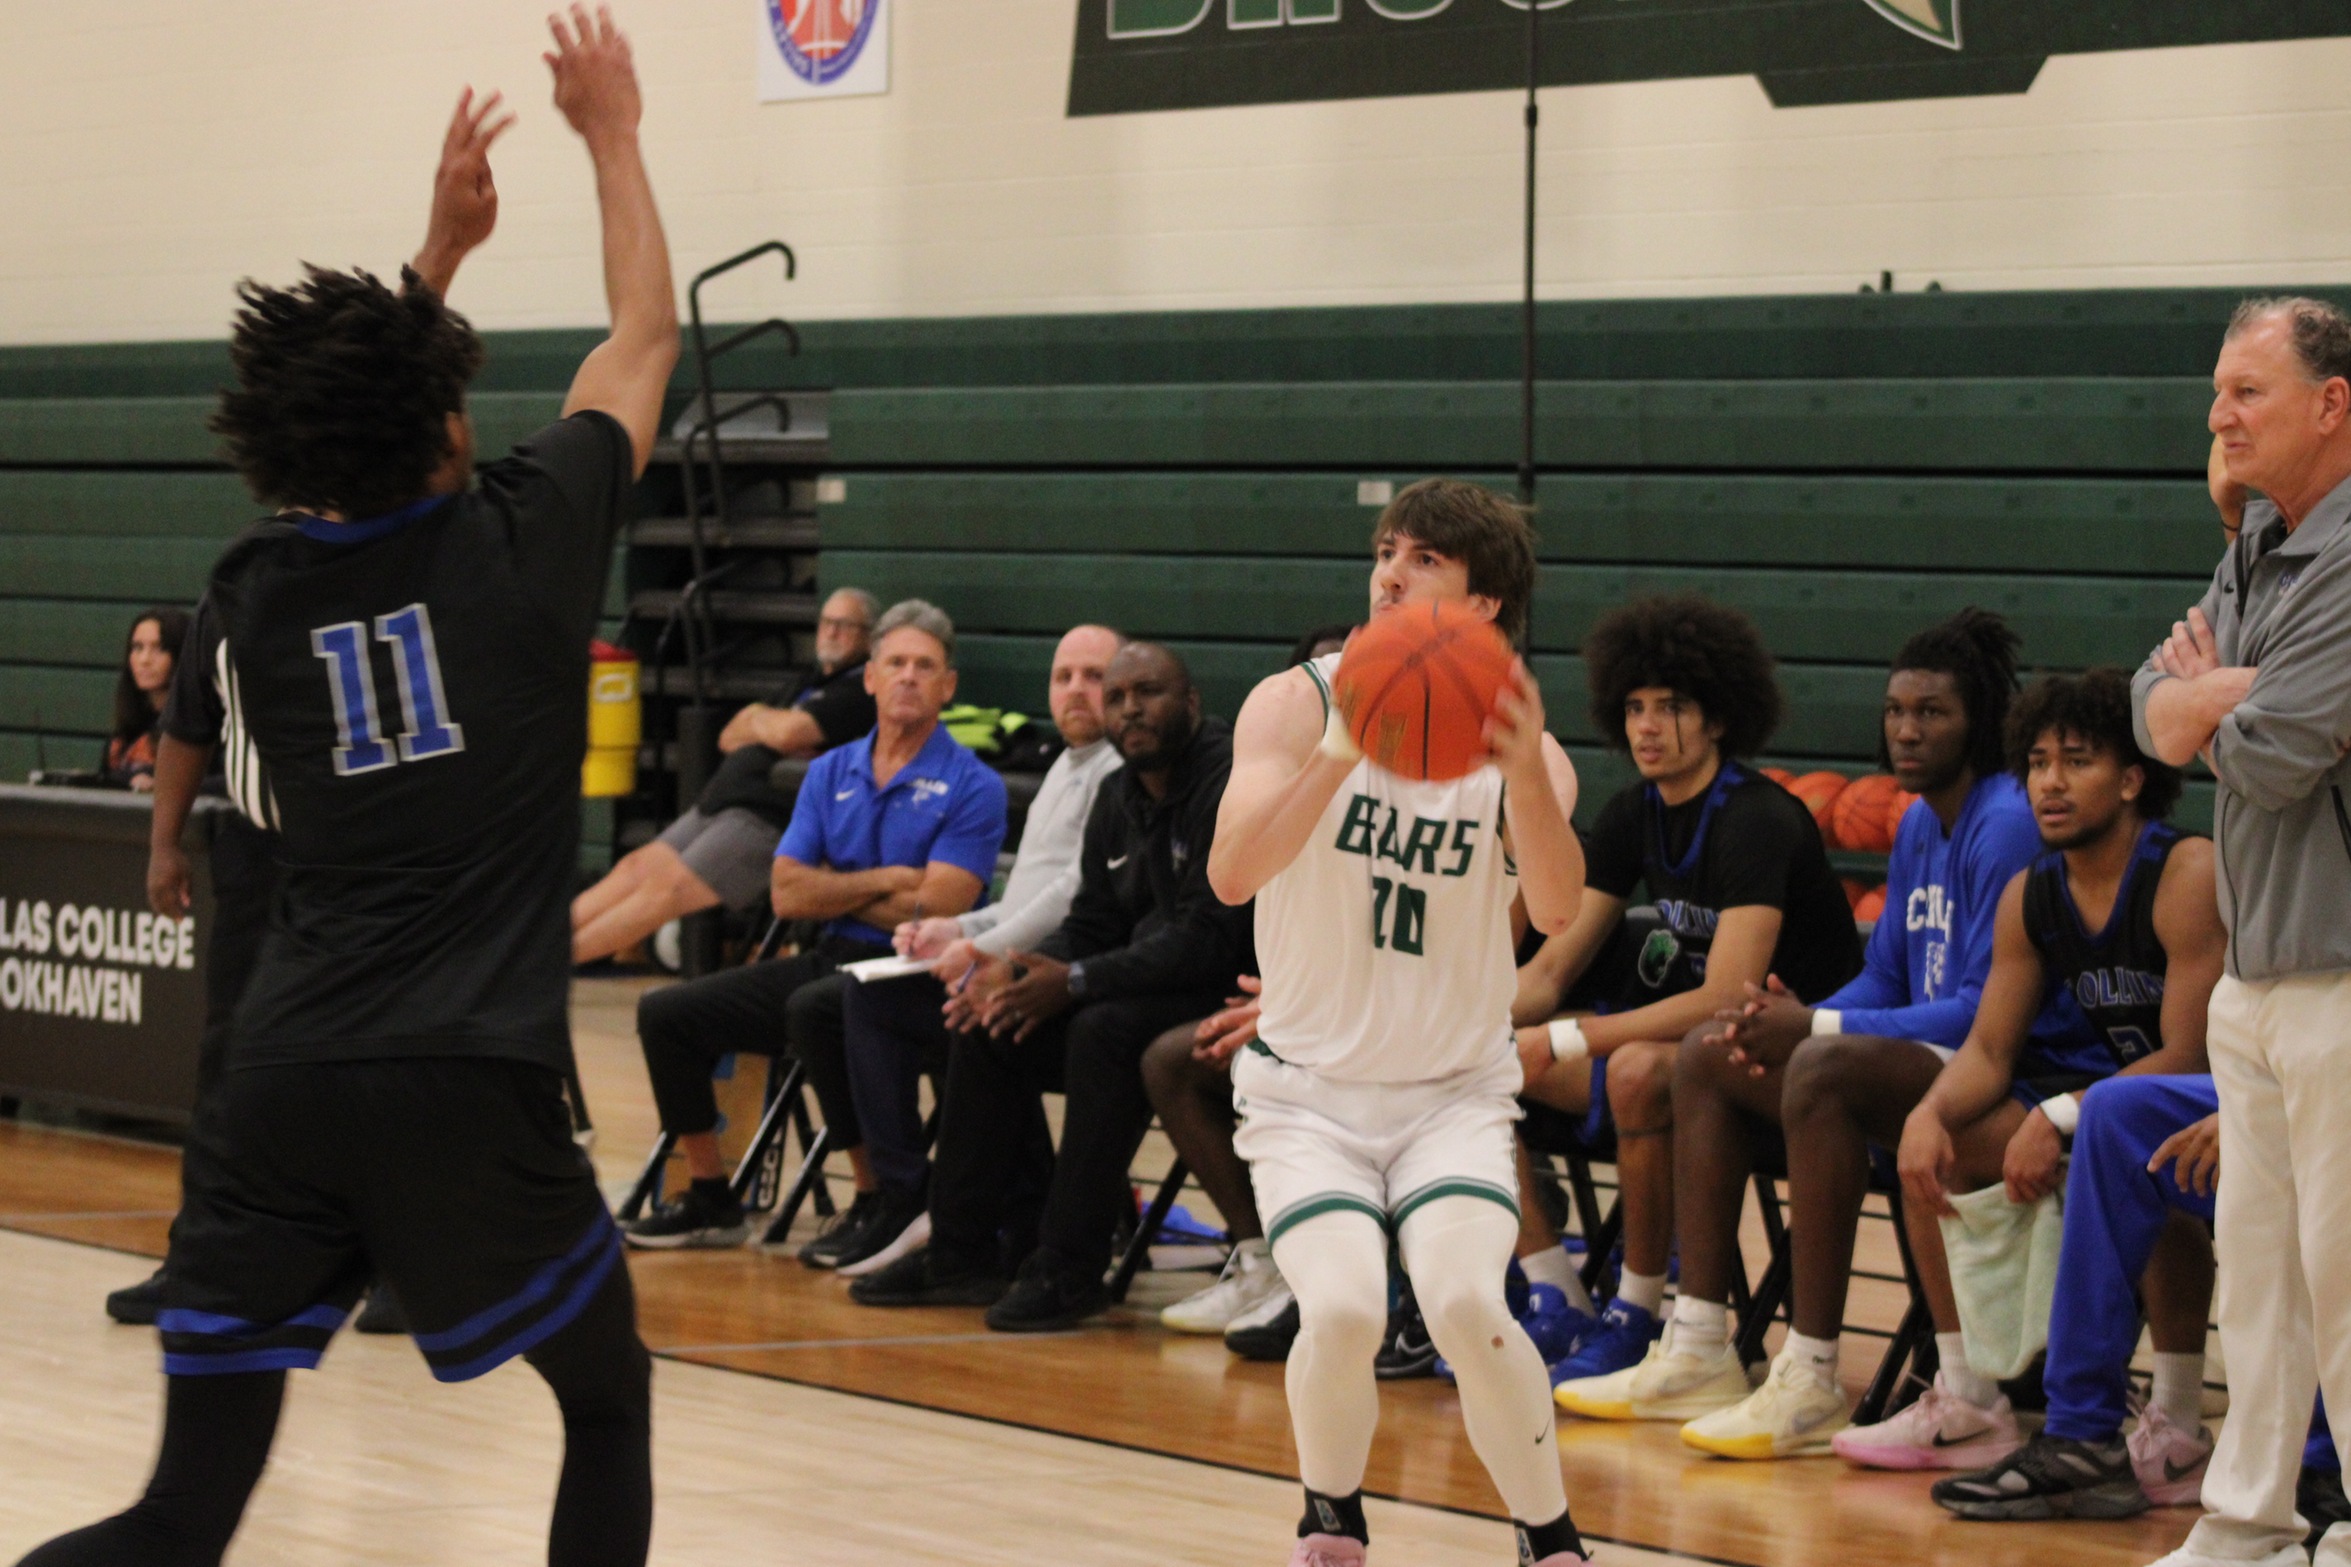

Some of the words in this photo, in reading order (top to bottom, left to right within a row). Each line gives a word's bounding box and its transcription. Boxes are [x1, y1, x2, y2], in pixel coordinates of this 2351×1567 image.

[309, 602, 466, 776] 11
[56, 903, 196, 970] COLLEGE
[0, 956, 142, 1025] OKHAVEN
